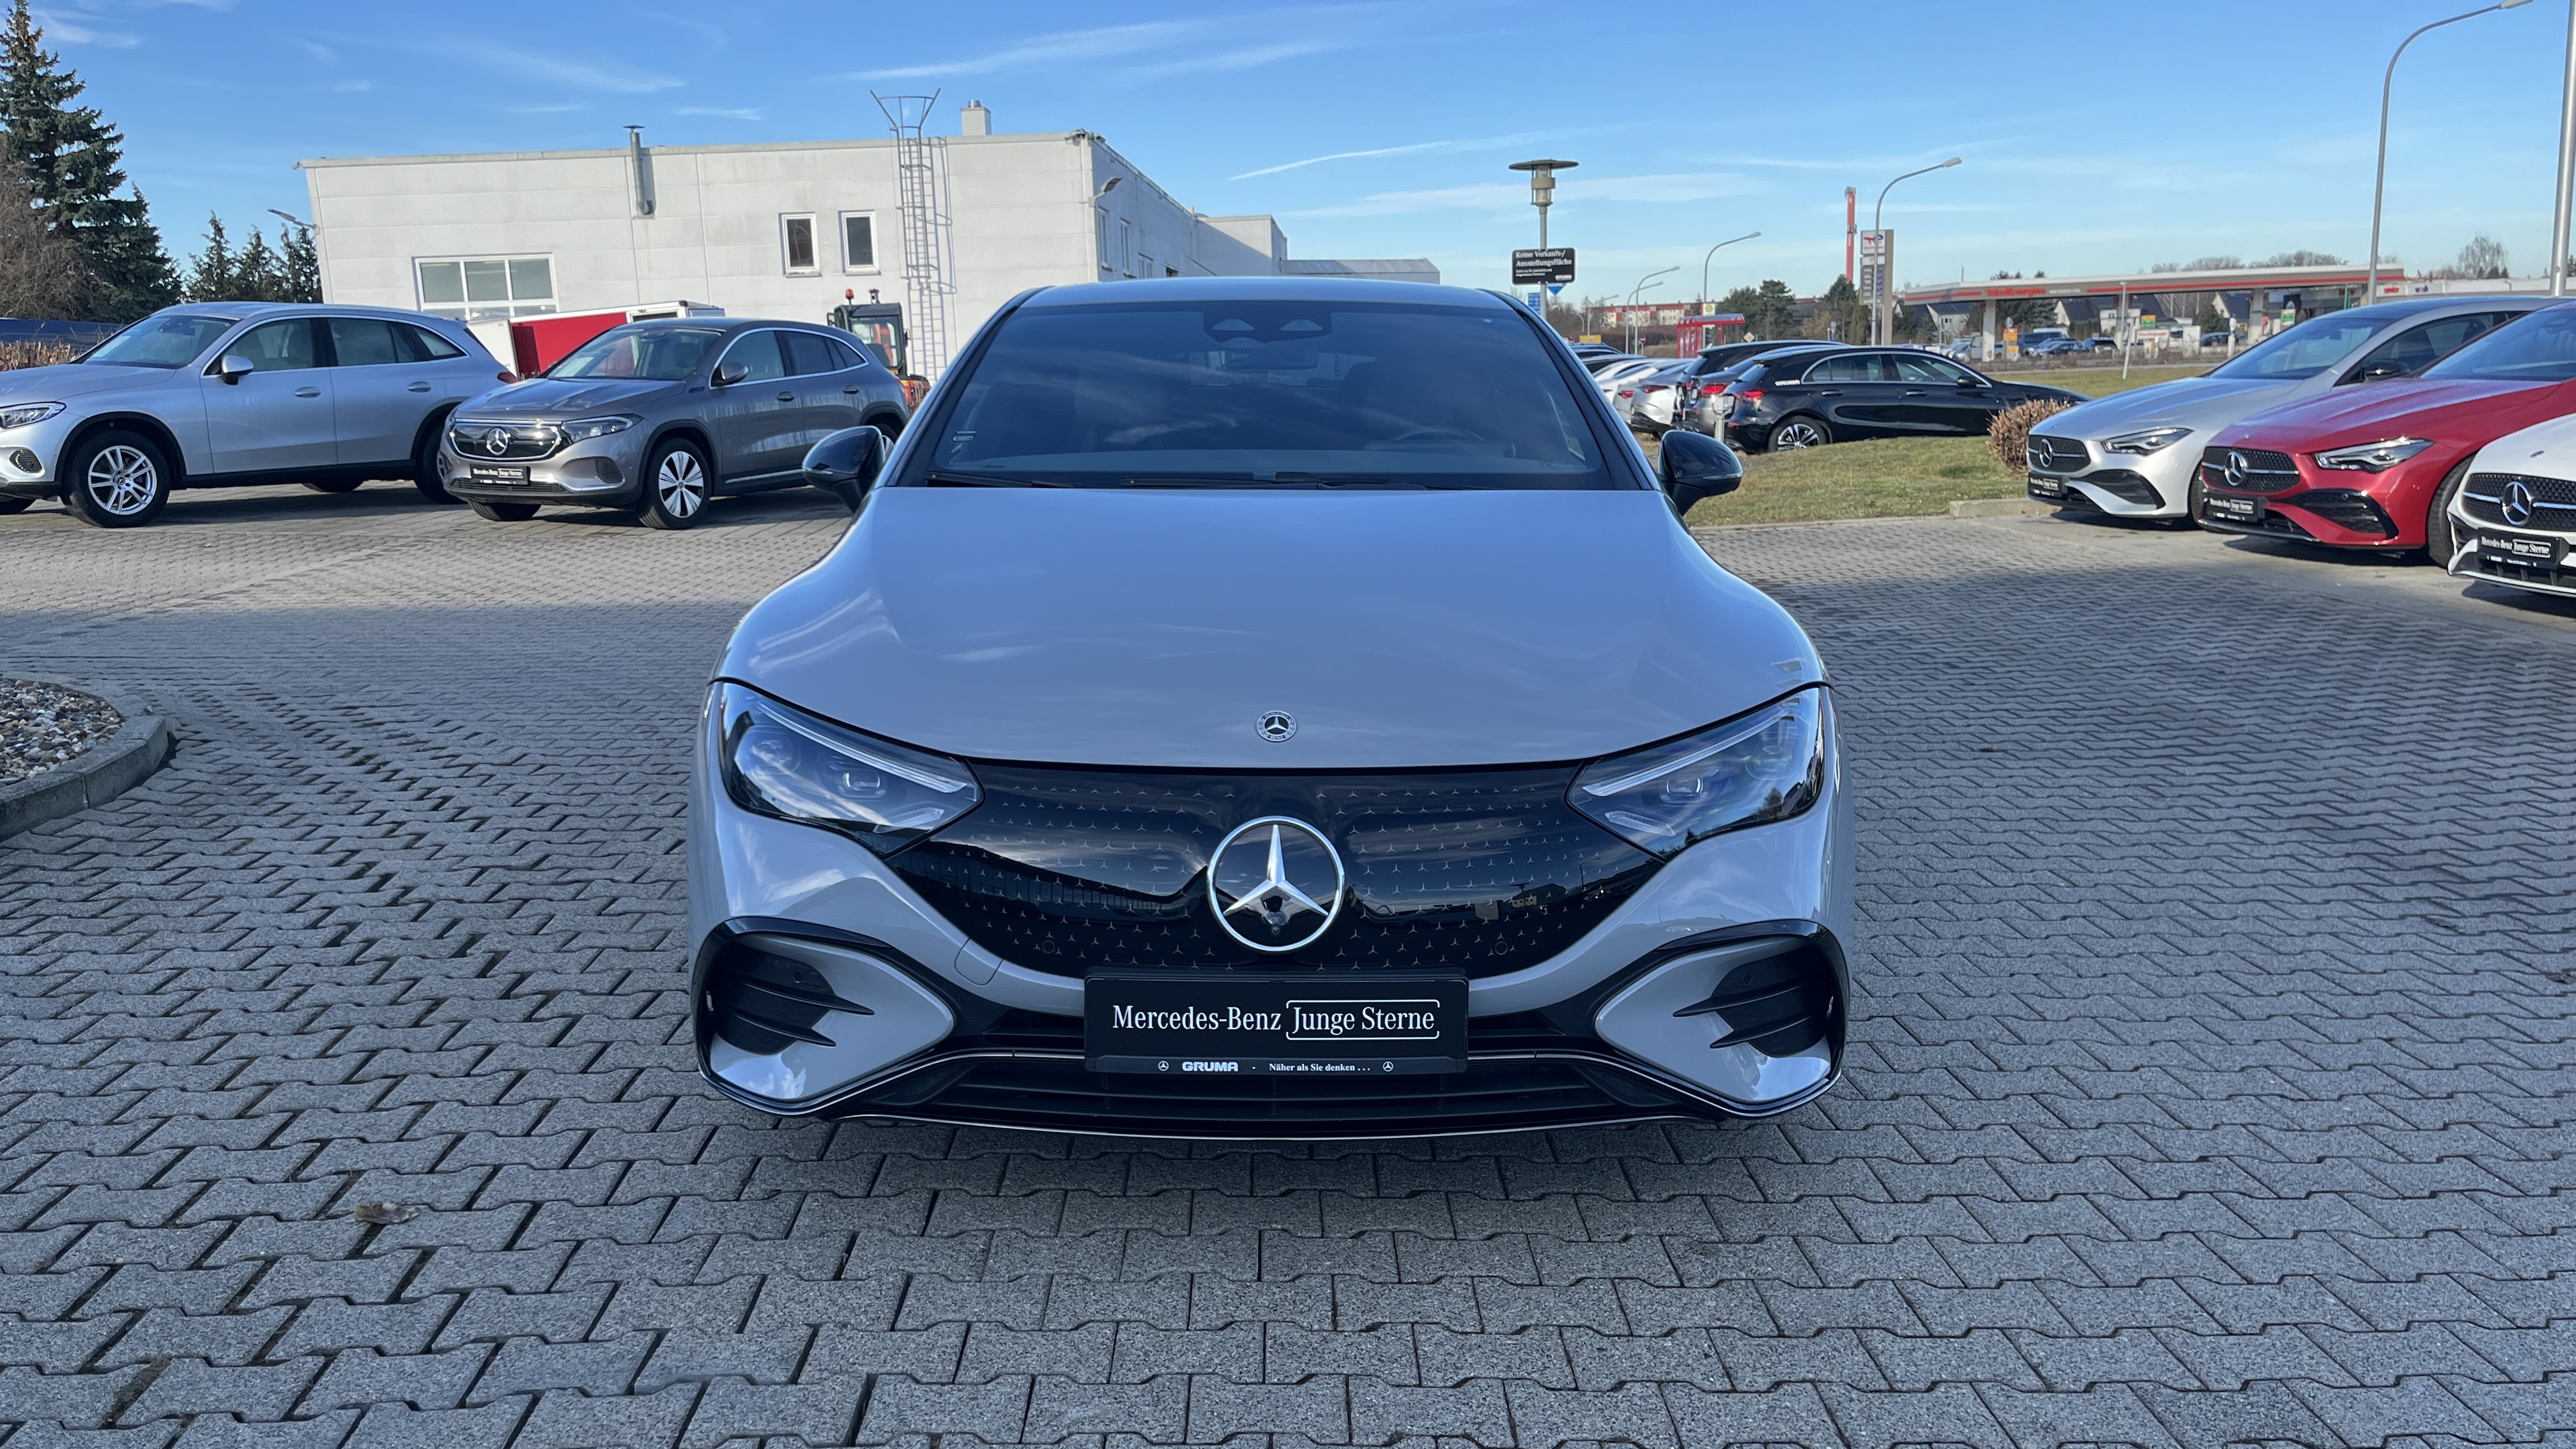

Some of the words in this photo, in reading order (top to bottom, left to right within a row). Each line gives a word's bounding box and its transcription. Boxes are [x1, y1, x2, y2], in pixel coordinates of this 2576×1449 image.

[1515, 258, 1572, 267] Ausstellungsfläche
[1112, 1005, 1281, 1030] Mercedes-Benz
[1292, 1007, 1355, 1036] Junge
[1362, 1006, 1434, 1030] Sterne
[1182, 1061, 1239, 1072] GRUMA
[1269, 1063, 1295, 1071] Näher
[1296, 1063, 1308, 1071] als
[1310, 1063, 1323, 1071] Sie
[1325, 1063, 1355, 1071] denken
